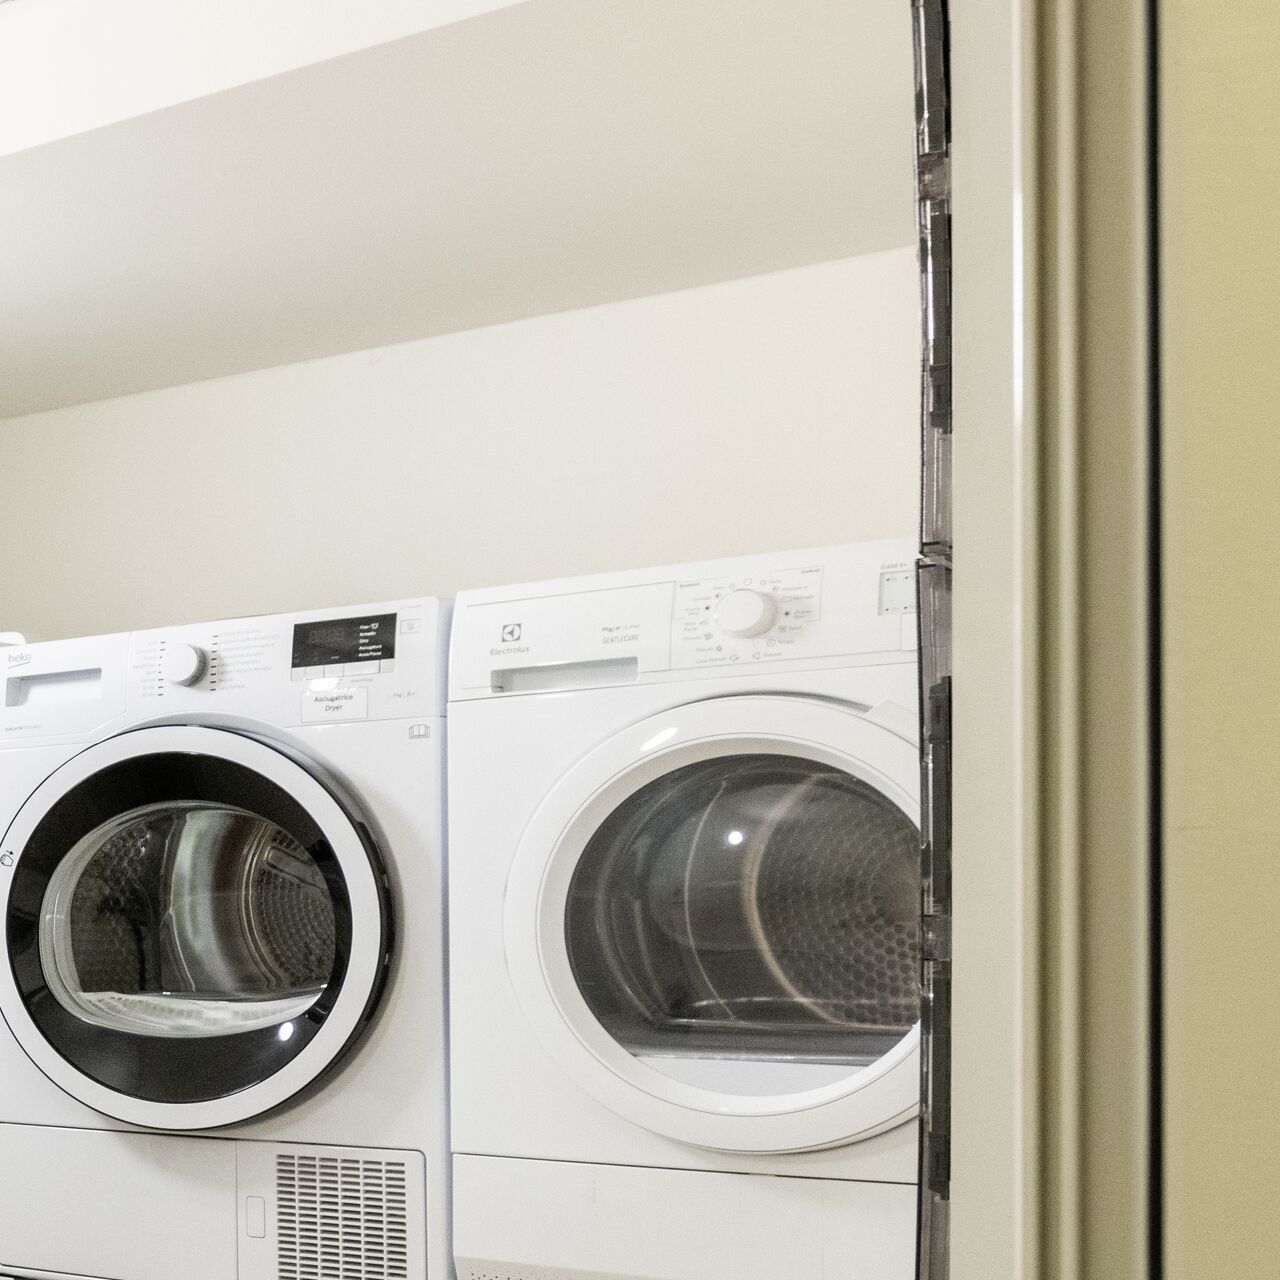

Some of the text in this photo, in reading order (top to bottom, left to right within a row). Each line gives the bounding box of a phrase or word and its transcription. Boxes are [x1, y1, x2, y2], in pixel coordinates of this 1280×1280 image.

[490, 646, 530, 656] Electrolux
[8, 653, 32, 663] beko
[314, 694, 354, 703] Asciugatrice
[325, 704, 343, 713] Dryer
